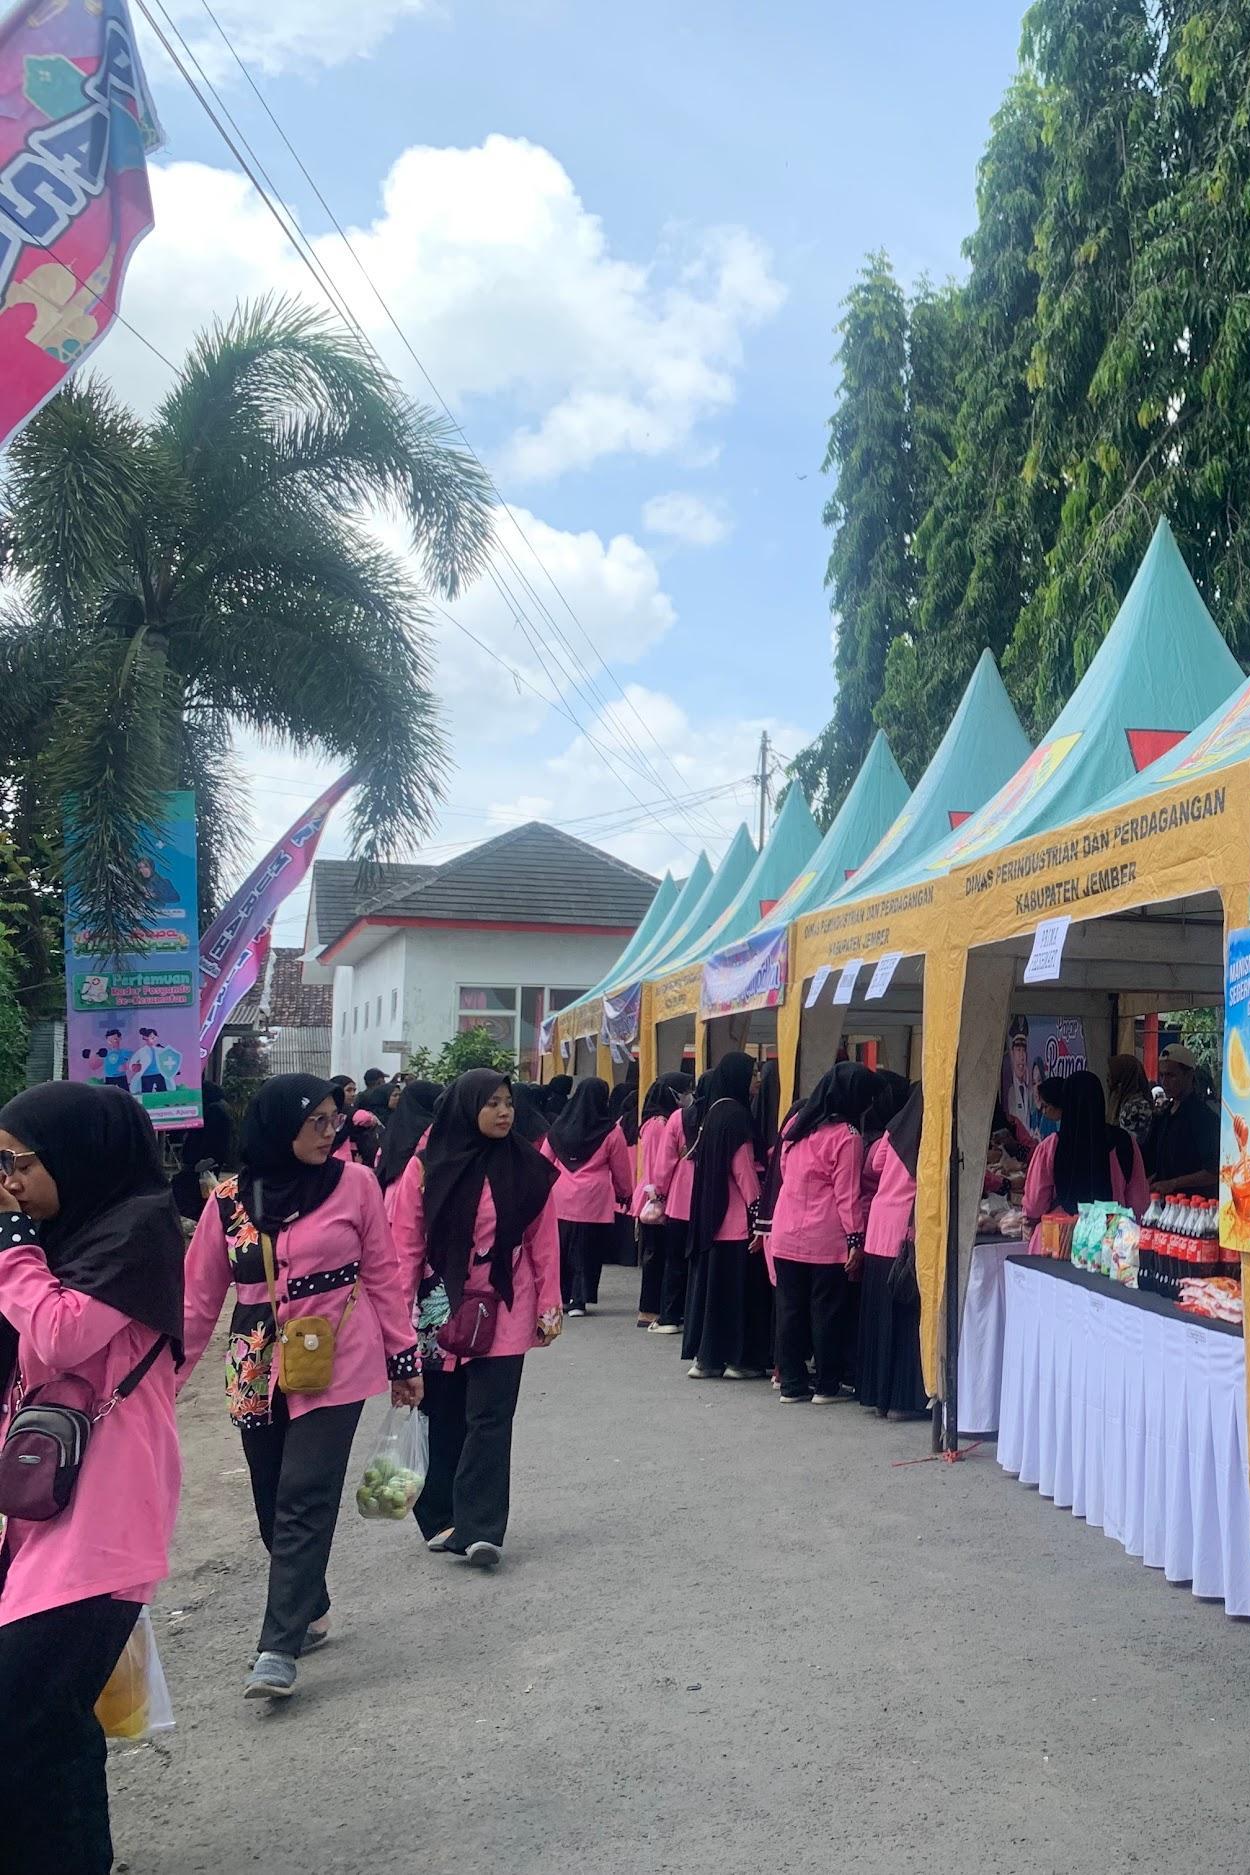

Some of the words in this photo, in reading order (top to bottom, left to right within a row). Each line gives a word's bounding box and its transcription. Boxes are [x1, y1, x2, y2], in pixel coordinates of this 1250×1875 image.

[965, 869, 994, 896] DINAS
[995, 838, 1080, 885] PERINDUSTRIAN
[1083, 828, 1110, 858] DAN
[1114, 786, 1227, 848] PERDAGANGAN
[1015, 877, 1080, 915] KABUPATEN
[1084, 861, 1137, 897] JEMBER
